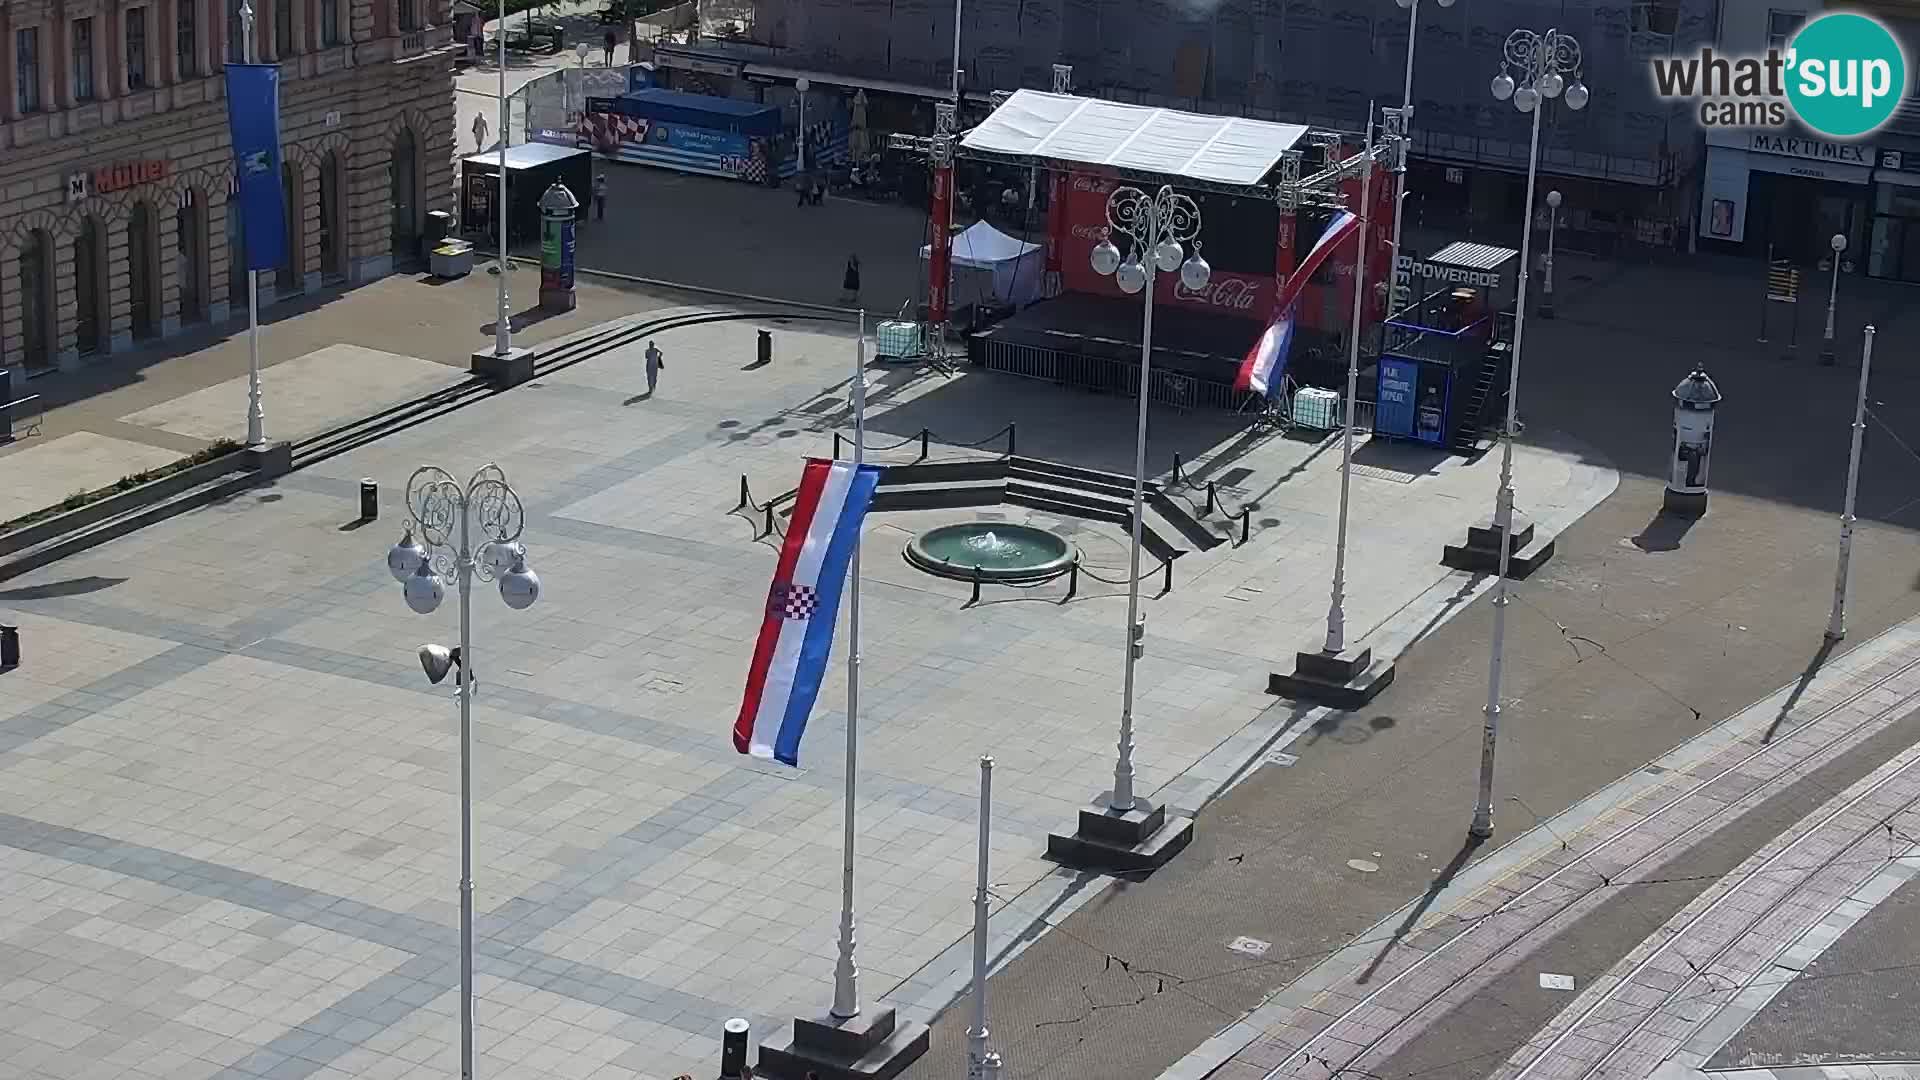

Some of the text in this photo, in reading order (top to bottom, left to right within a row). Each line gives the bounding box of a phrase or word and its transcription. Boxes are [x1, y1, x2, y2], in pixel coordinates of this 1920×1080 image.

[1754, 135, 1865, 162] MARTIMEX
[1411, 262, 1501, 288] POWERADE
[1174, 279, 1261, 309] Coca-Cola
